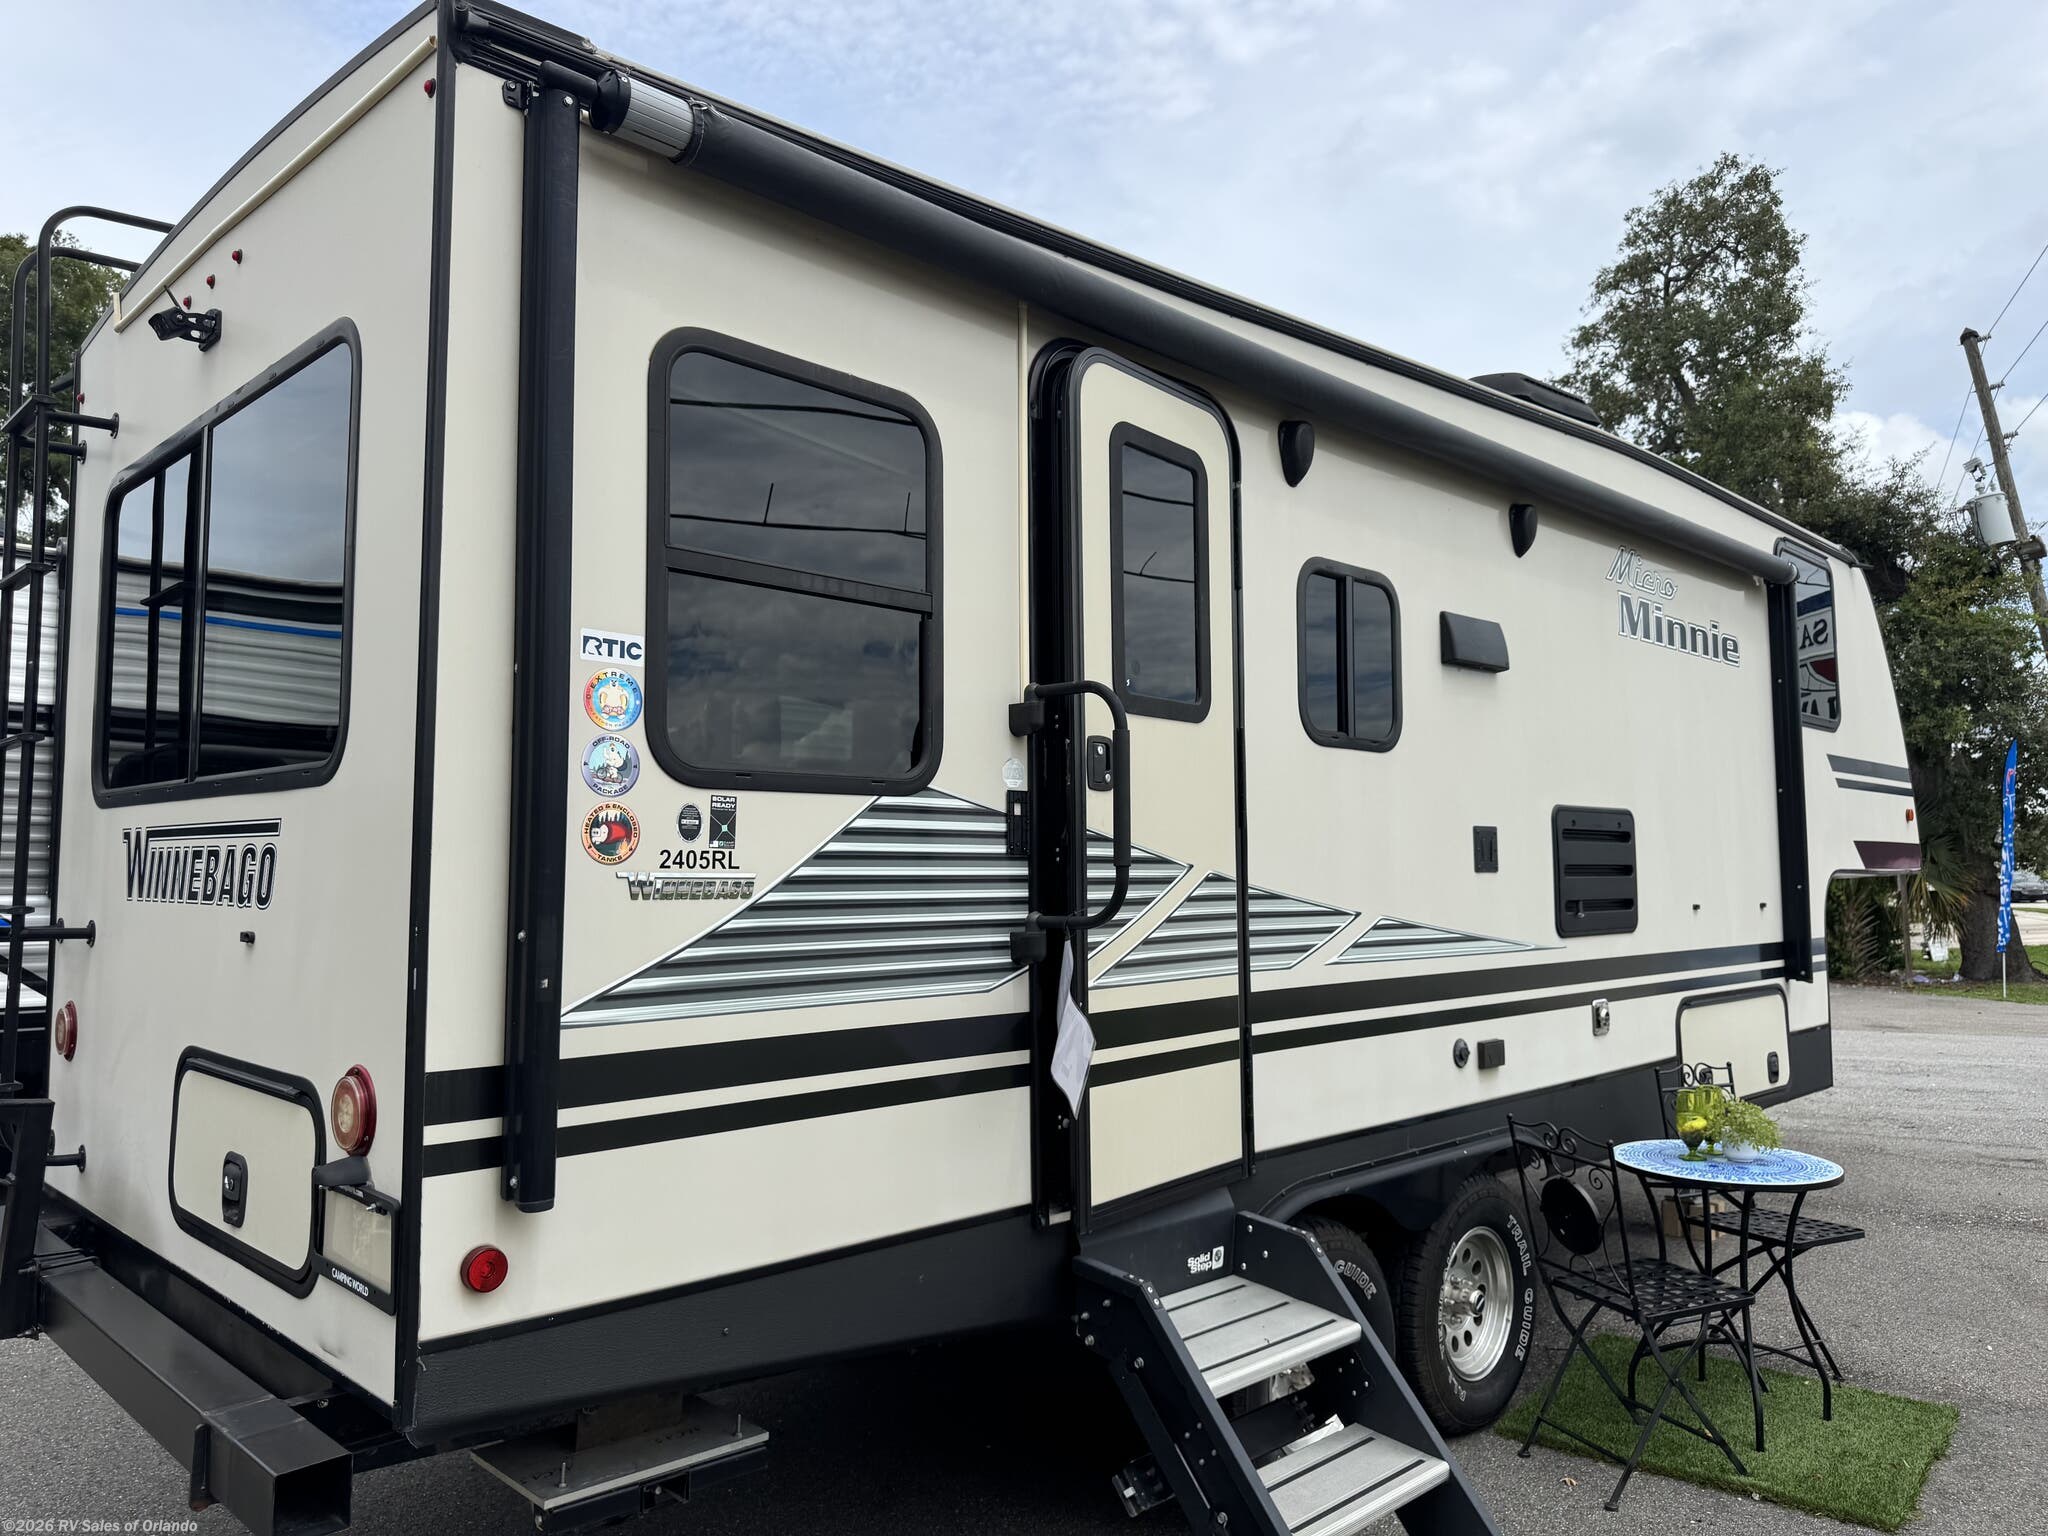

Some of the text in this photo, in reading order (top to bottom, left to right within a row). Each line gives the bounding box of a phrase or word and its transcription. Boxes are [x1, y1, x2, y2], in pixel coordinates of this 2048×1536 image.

[1606, 545, 1678, 600] Micro
[1617, 590, 1741, 667] Minnie
[583, 635, 642, 660] RTIC
[590, 671, 638, 694] EXTREME
[592, 736, 631, 749] OFF-ROAD
[592, 783, 629, 795] PACKAGE
[584, 804, 604, 834] HEATED
[612, 804, 638, 838] ENCLOSED
[122, 818, 282, 910] WINNEBAGO
[597, 853, 623, 863] TANKS
[659, 849, 740, 869] 2405RL
[616, 872, 757, 900] WINNEBAGO
[1187, 1251, 1211, 1267] Solid
[1508, 1214, 1533, 1276] TRAIL
[331, 1267, 369, 1297] CAMPING WORLD
[1334, 1260, 1377, 1300] GUIDE
[1515, 1288, 1534, 1361] GUIDE
